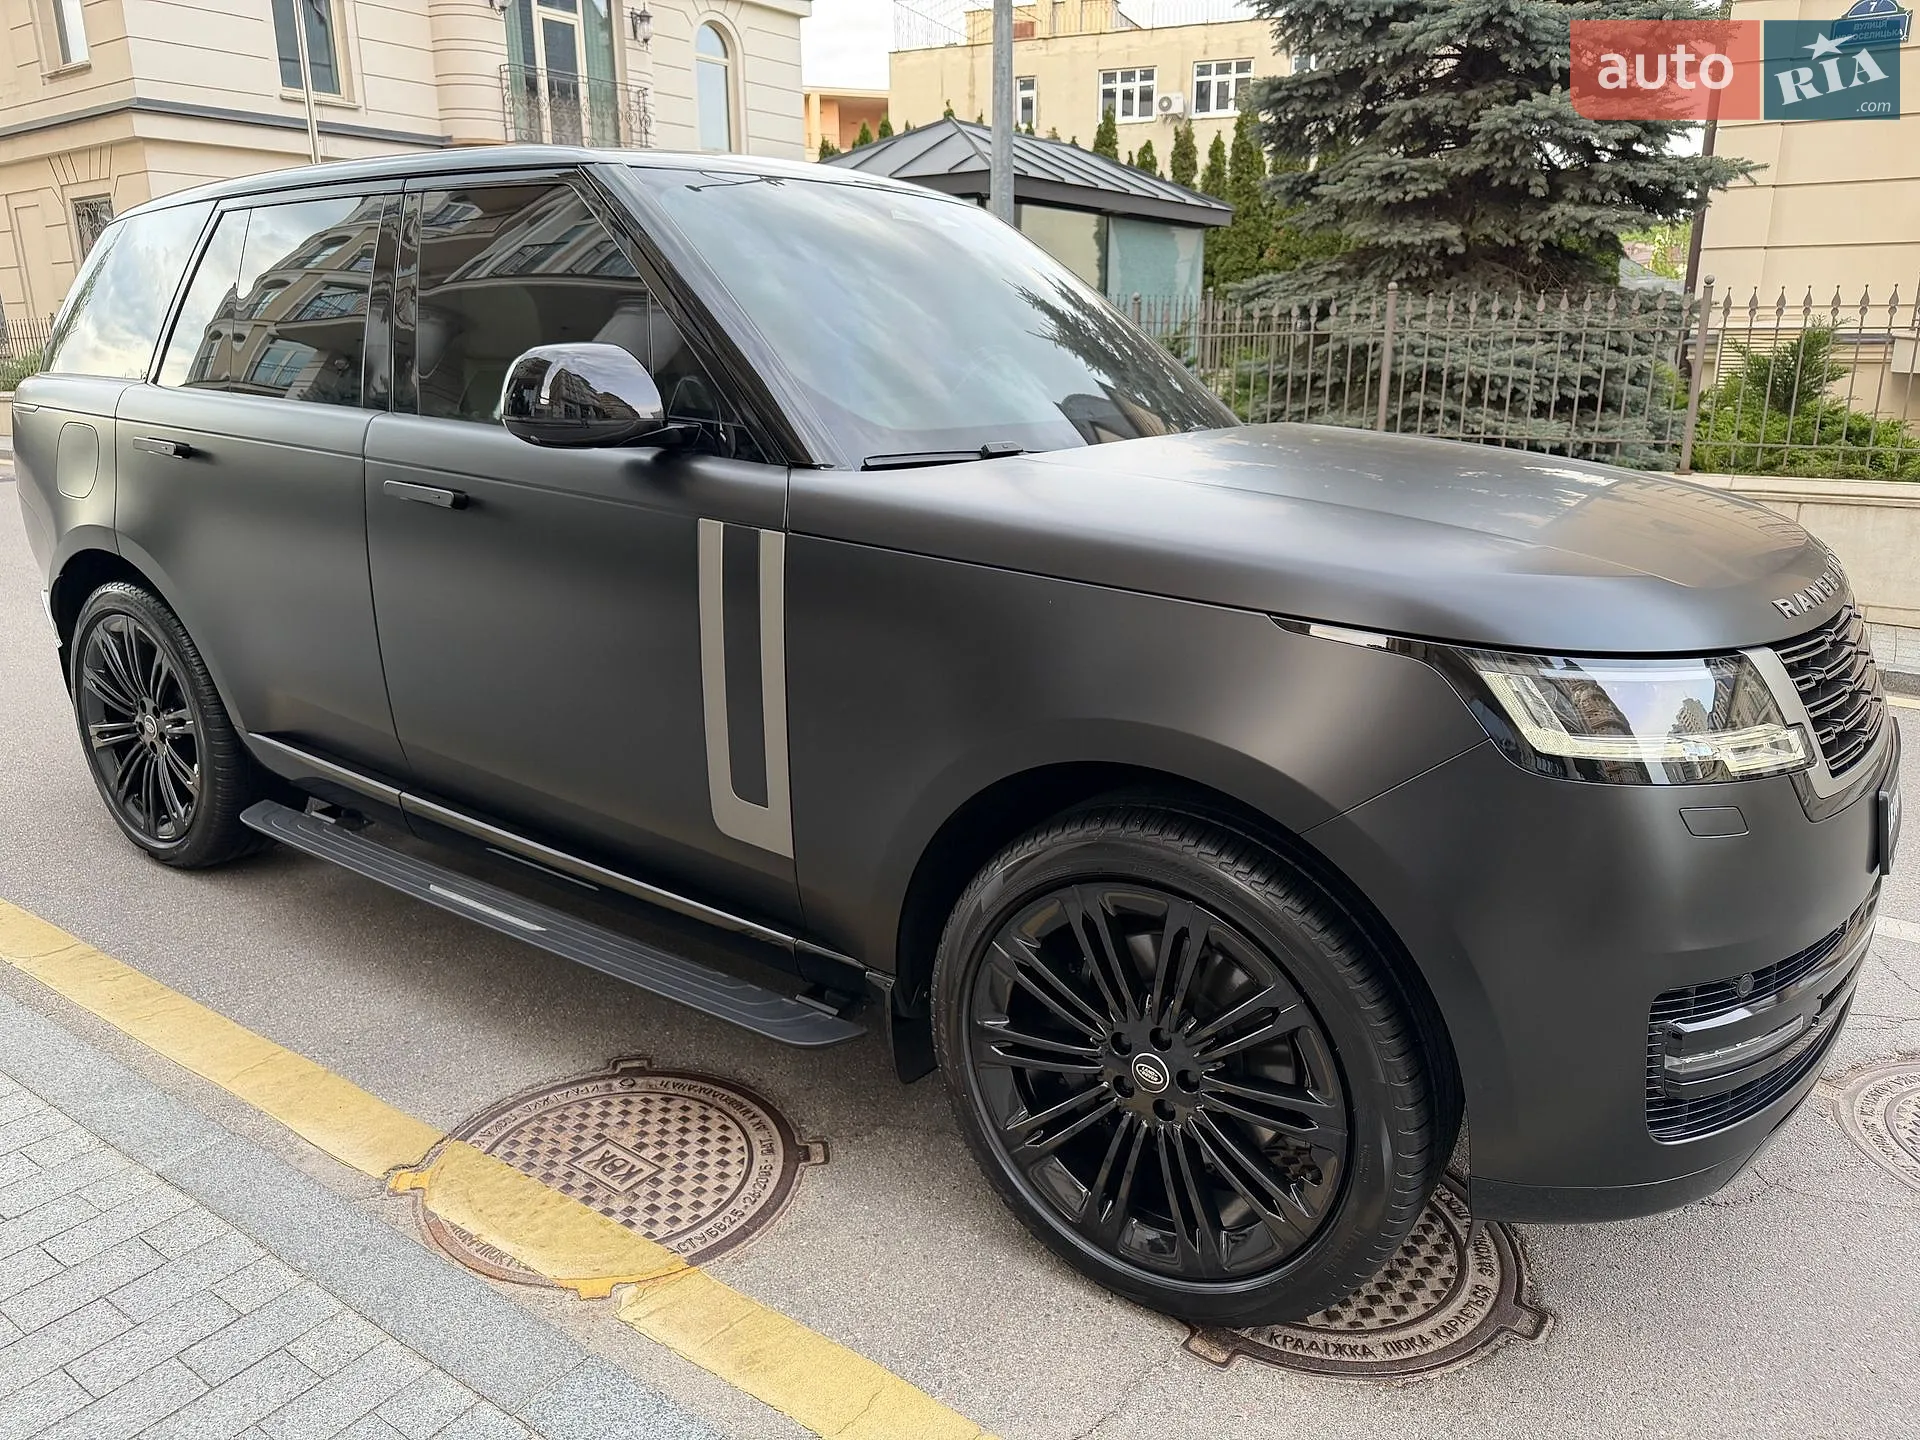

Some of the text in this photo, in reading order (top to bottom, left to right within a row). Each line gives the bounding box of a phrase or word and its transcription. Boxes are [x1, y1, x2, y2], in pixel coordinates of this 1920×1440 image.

[1870, 1, 1878, 12] 7
[1853, 20, 1888, 31] ВУЛИЦЯ
[1771, 571, 1840, 620] RANGE
